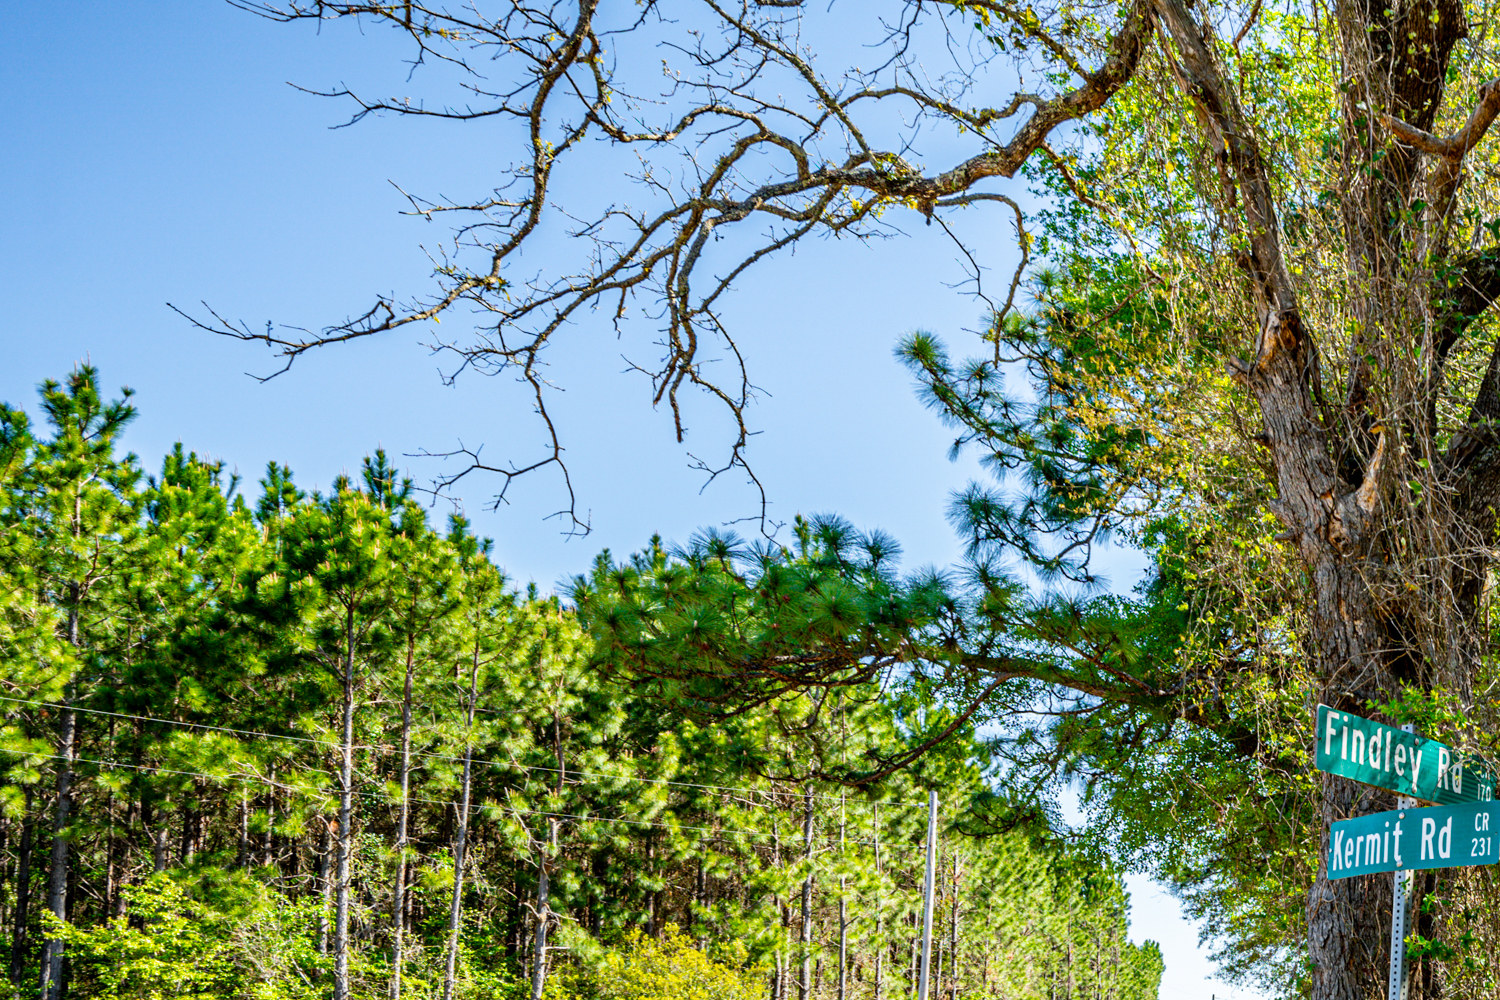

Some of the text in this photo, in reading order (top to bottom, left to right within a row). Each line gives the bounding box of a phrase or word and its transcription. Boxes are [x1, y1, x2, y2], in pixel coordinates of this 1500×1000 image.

[1324, 709, 1463, 795] Findley Rd
[1477, 783, 1492, 802] 170
[1474, 812, 1490, 832] CR
[1332, 815, 1453, 872] Kermit Rd
[1470, 836, 1492, 858] 231
